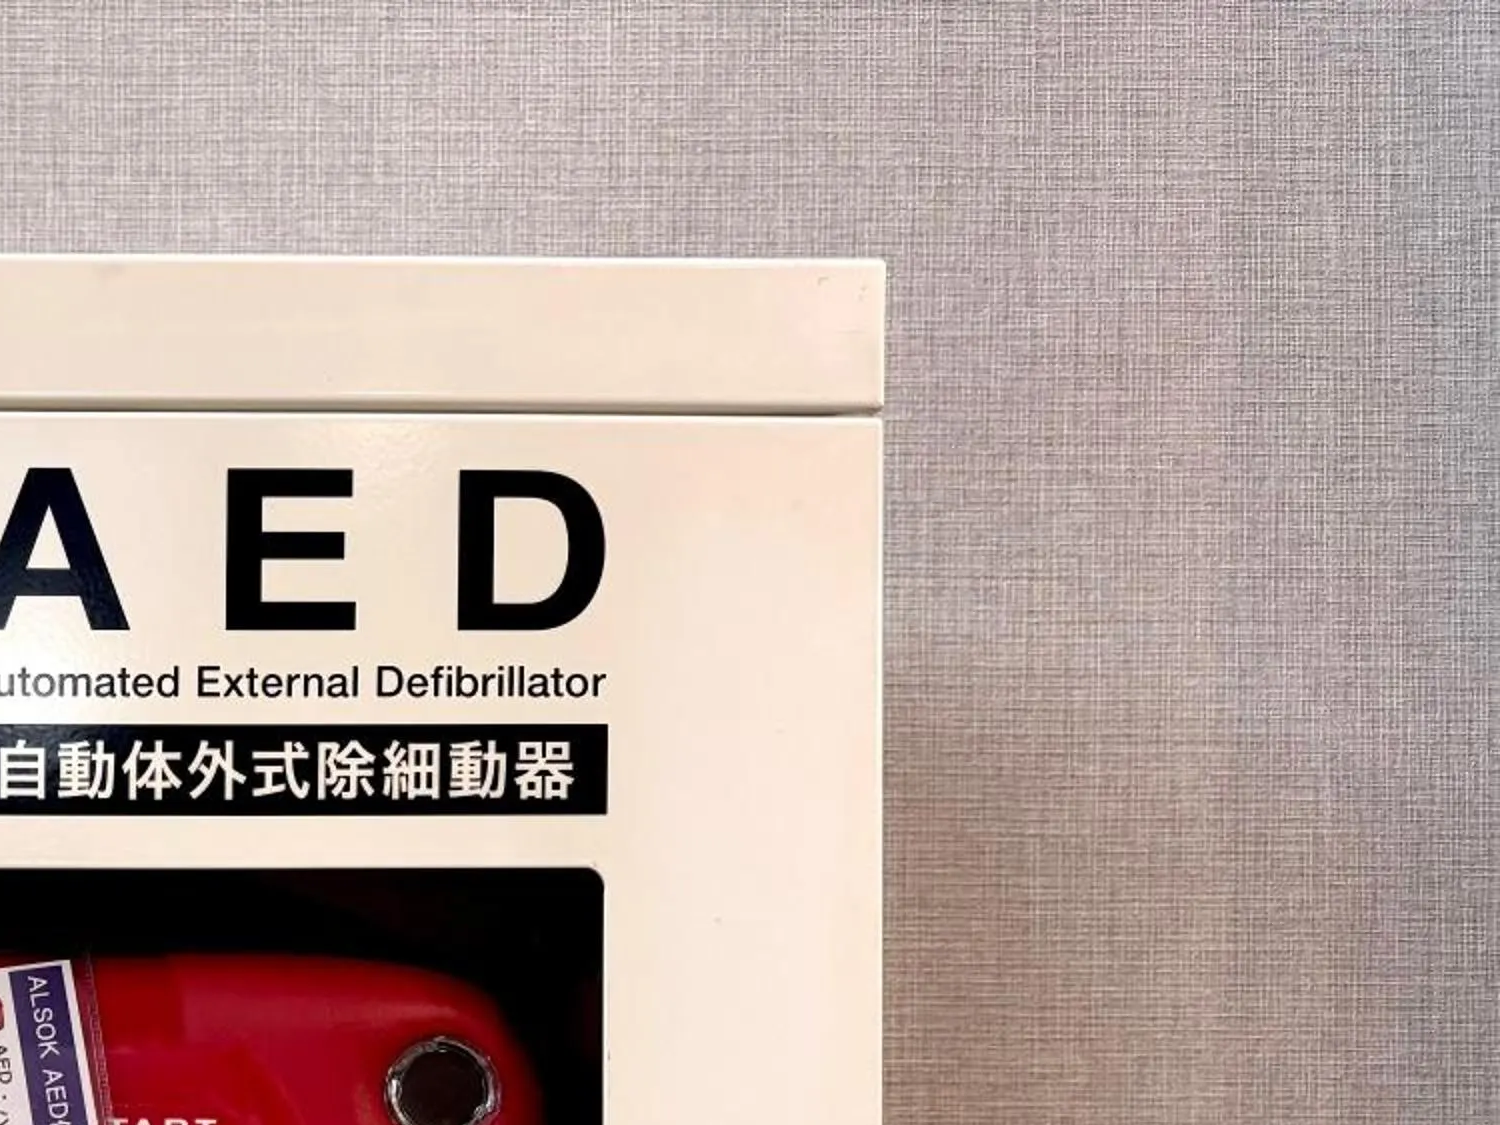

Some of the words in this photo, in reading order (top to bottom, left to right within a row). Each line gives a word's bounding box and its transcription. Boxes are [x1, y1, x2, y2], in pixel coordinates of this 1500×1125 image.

[198, 665, 360, 700] External
[376, 665, 607, 700] Defibrillator
[26, 974, 62, 1060] ALSOK
